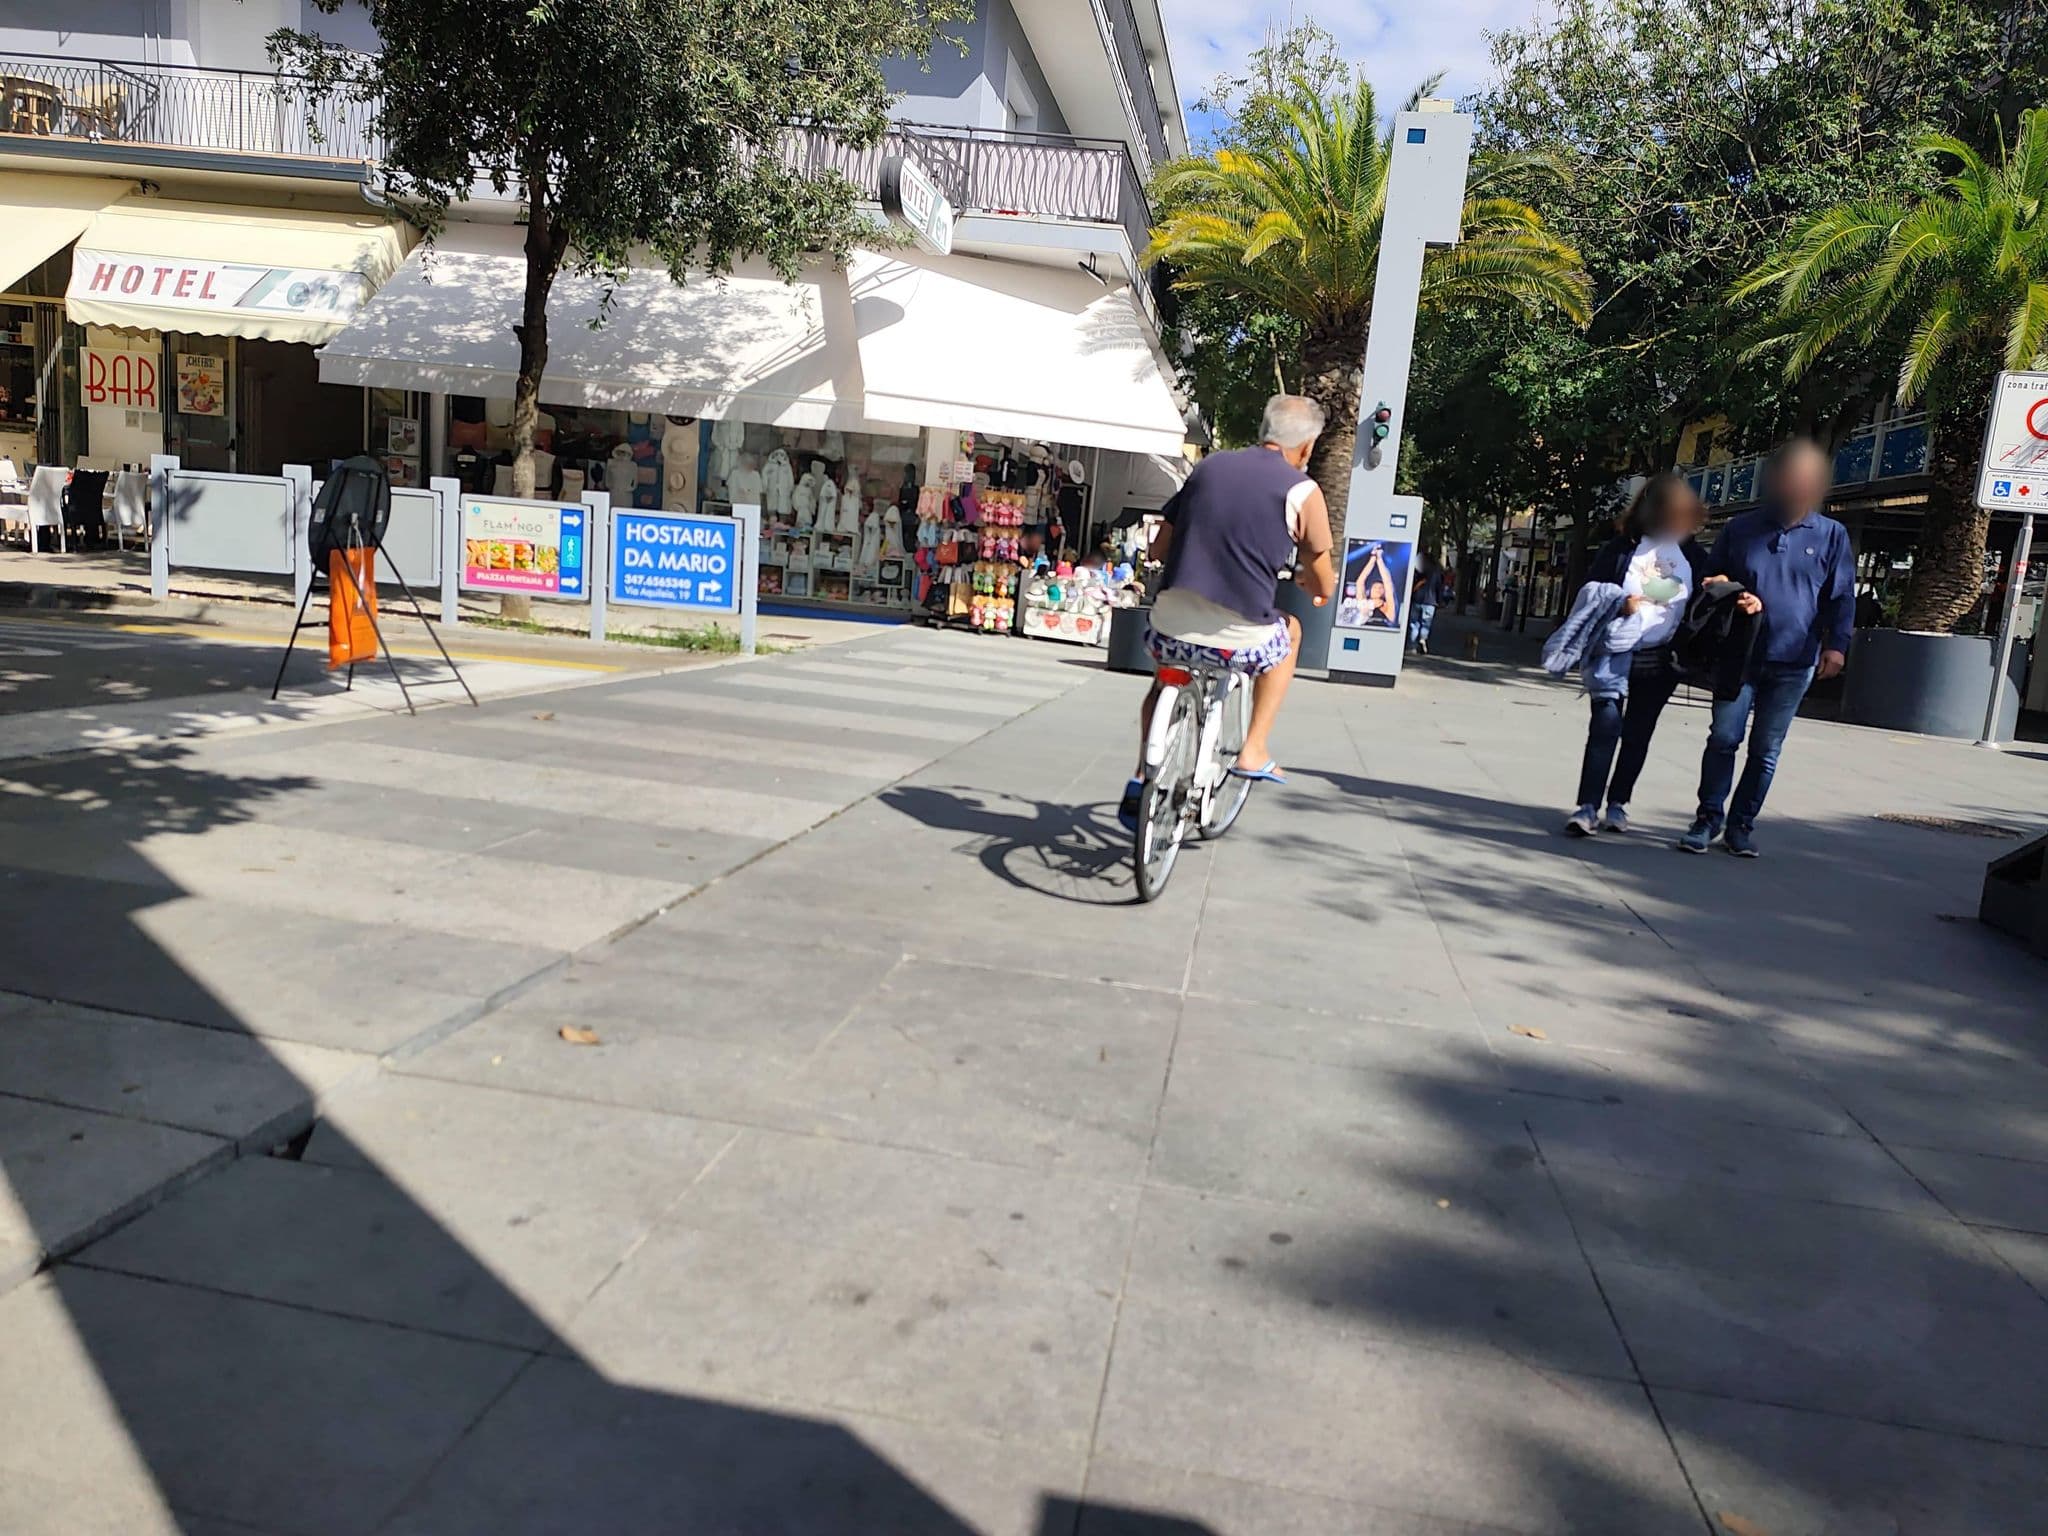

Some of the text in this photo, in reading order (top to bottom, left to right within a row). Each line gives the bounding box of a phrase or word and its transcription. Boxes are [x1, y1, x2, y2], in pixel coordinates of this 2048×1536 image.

[901, 171, 929, 217] HOTEL
[88, 263, 340, 312] HOTEL Zen
[84, 352, 156, 408] BAR
[2007, 381, 2028, 389] zona
[626, 522, 726, 549] HOSTARIA
[624, 547, 727, 575] DA MARIO
[624, 585, 639, 596] Via
